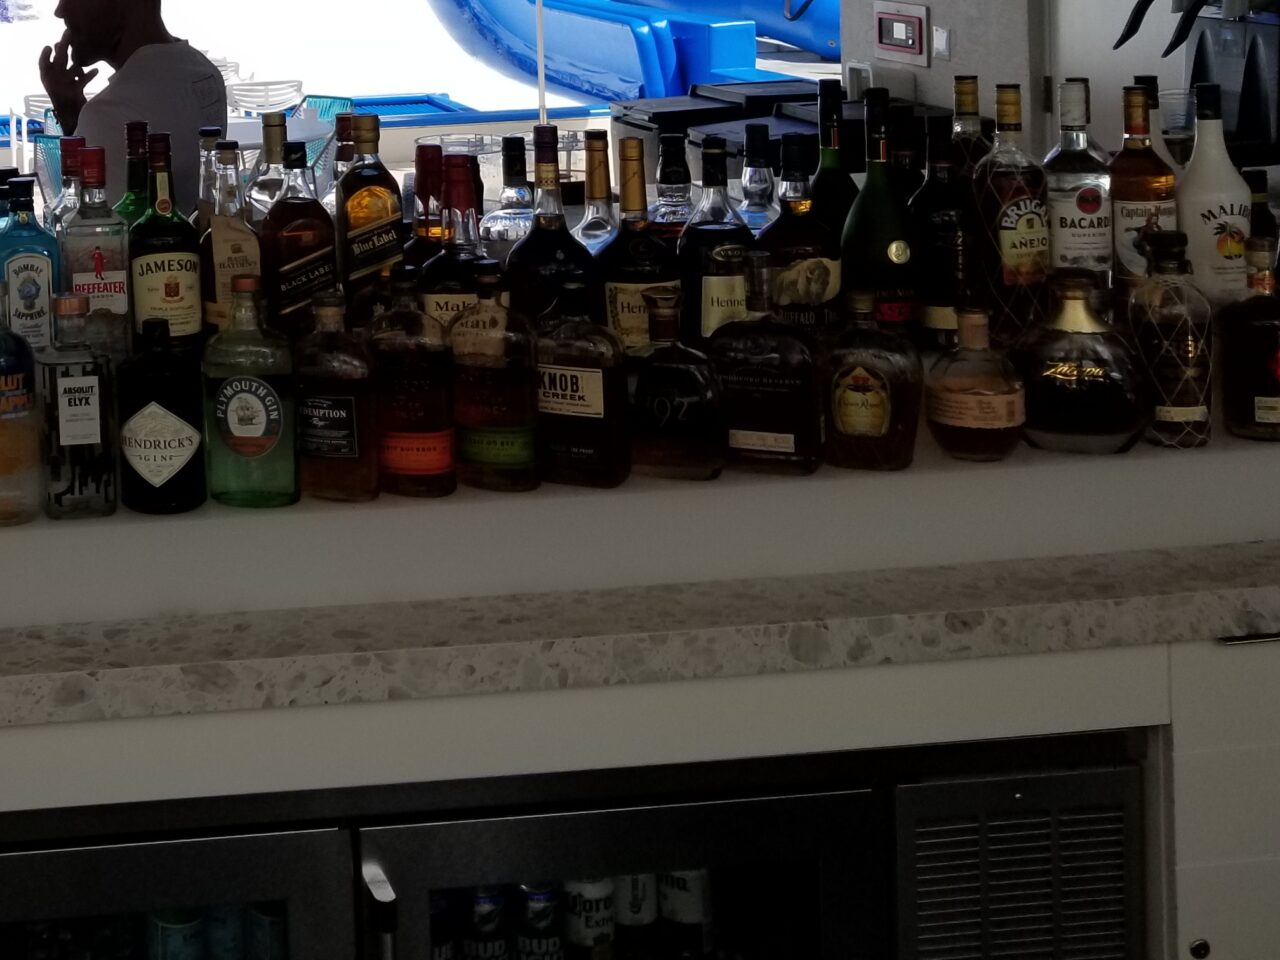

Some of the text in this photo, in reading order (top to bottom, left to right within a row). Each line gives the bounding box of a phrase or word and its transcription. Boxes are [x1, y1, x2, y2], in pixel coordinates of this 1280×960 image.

[1060, 216, 1109, 229] BACARD
[352, 229, 397, 256] Blue Label
[13, 263, 43, 276] BOMBAY
[138, 259, 199, 277] JAMESON
[74, 281, 126, 295] BEEFEATER
[280, 274, 308, 291] BLACK
[710, 296, 744, 308] Henne
[13, 307, 47, 320] SAPPHIRE
[537, 369, 580, 393] KNOB
[63, 385, 95, 394] ABSOLUT
[542, 391, 586, 402] CREEK
[68, 396, 91, 407] ELYX
[216, 380, 281, 420] PLYMOUTH GIN
[121, 435, 194, 450] HENDRICK'S
[517, 936, 561, 954] BUD
